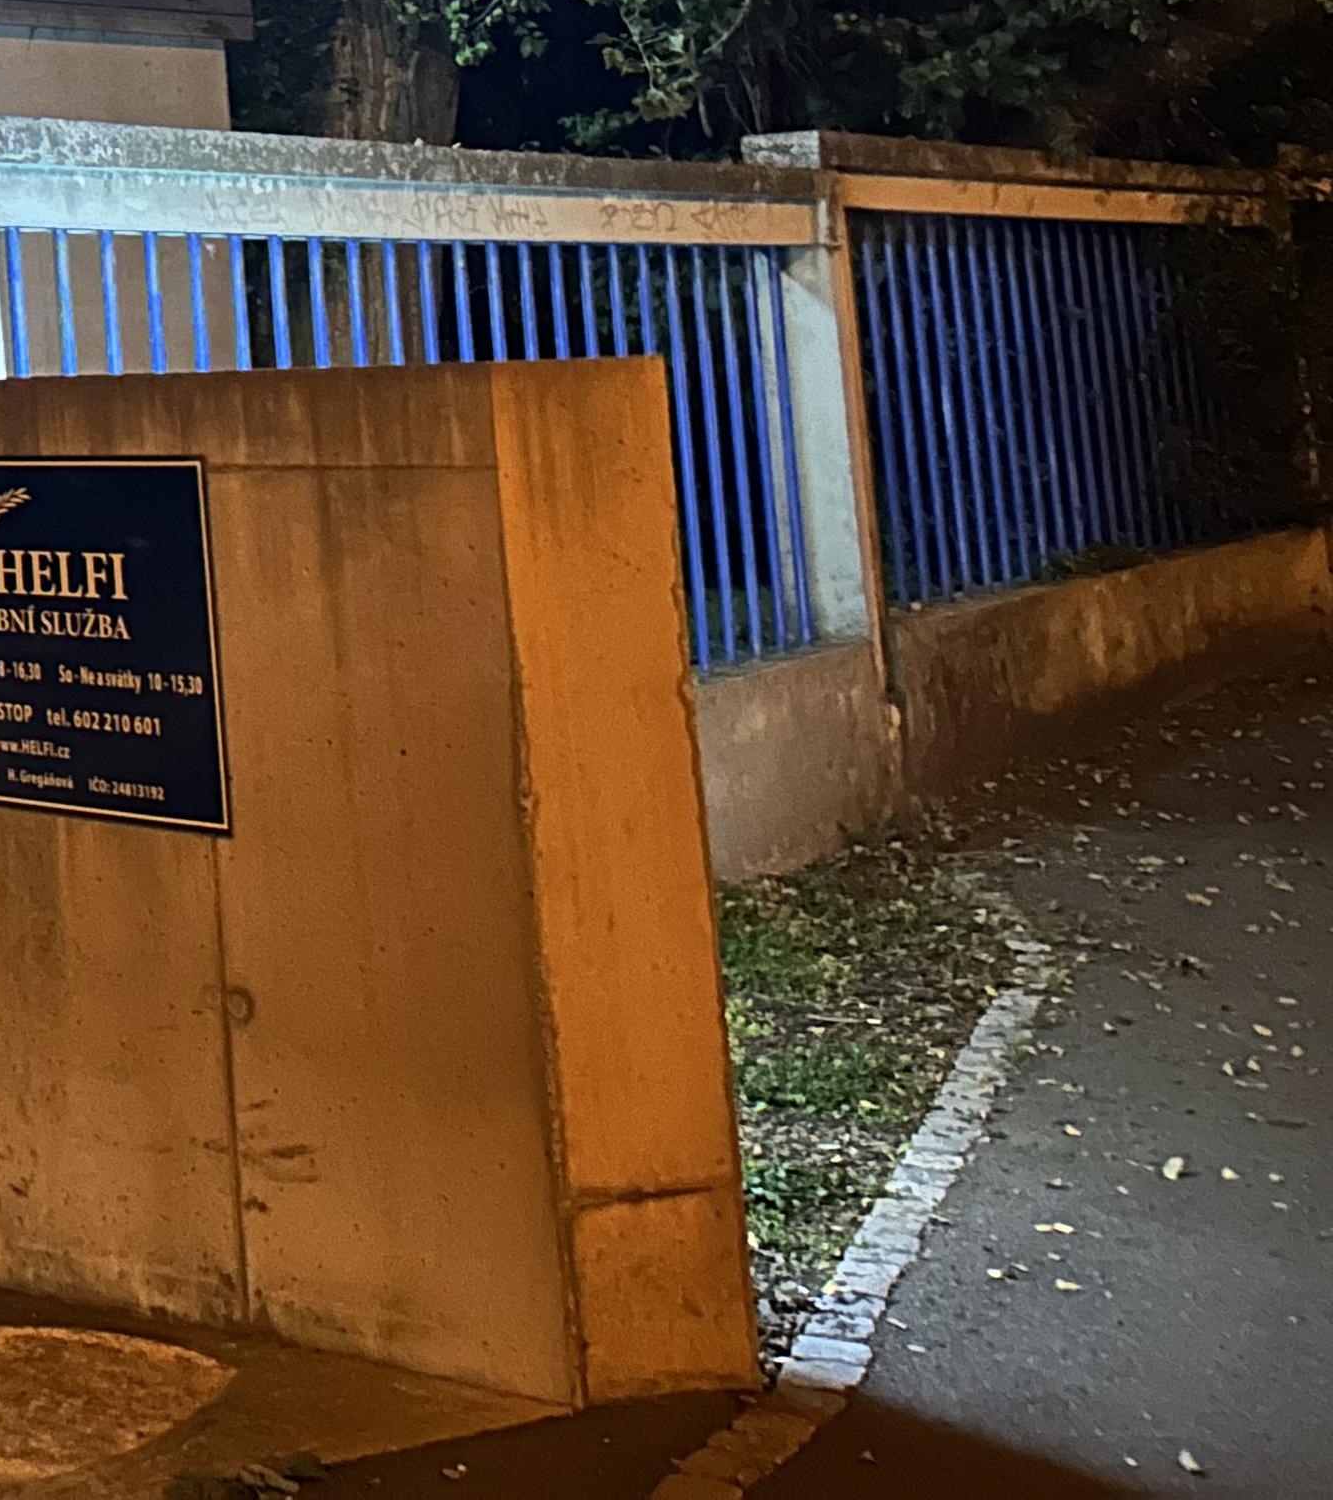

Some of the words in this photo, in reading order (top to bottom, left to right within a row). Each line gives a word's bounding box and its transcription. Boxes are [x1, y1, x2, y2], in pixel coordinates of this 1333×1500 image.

[41, 604, 131, 640] SLUŽBA
[46, 707, 71, 727] tel.
[73, 709, 100, 731] 602
[102, 712, 131, 734] 210
[133, 715, 161, 737] 601
